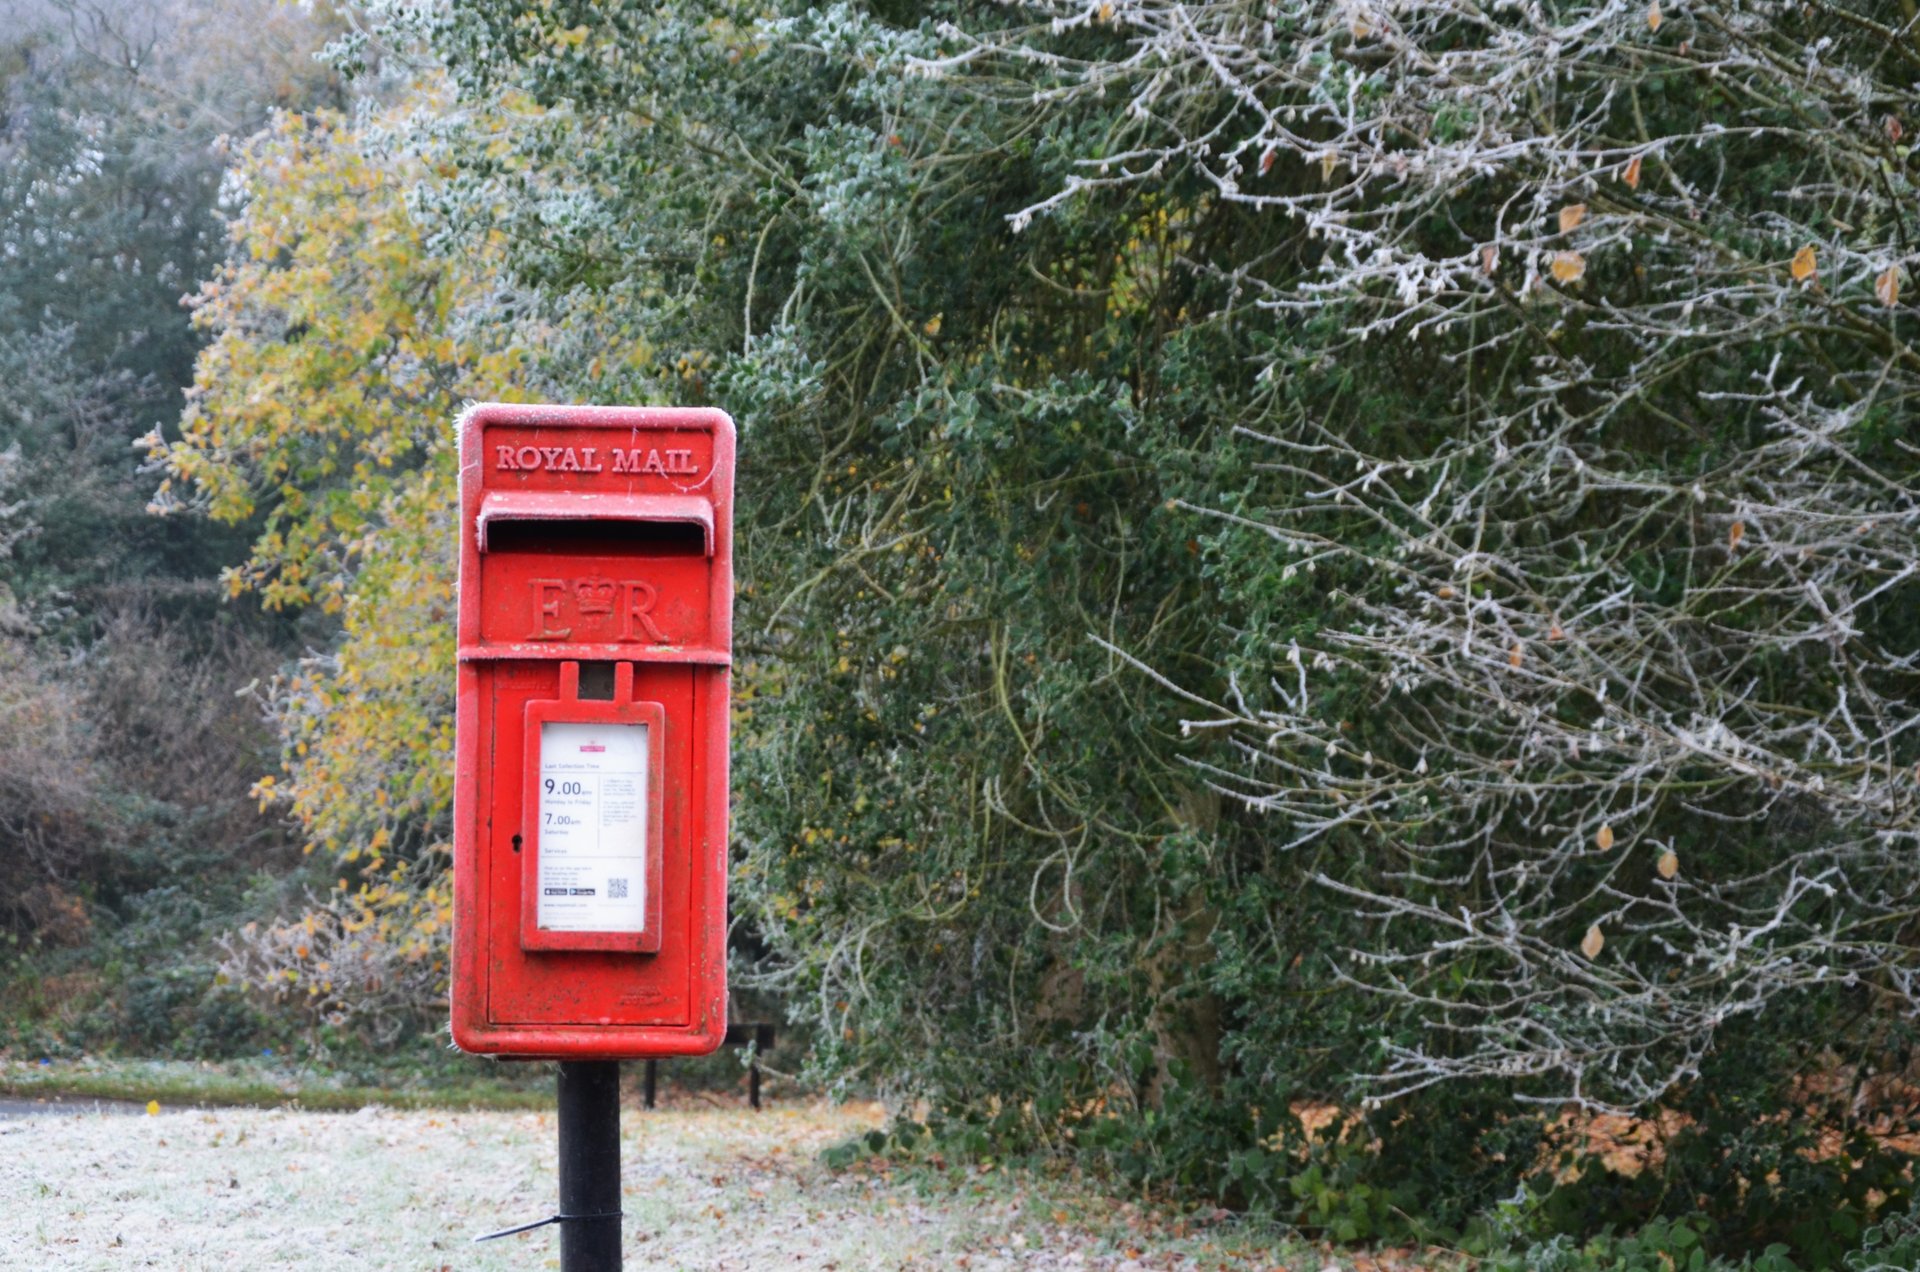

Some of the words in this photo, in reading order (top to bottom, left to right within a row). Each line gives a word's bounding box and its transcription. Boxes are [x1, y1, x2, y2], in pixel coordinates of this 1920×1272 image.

[496, 445, 602, 472] ROYAL
[612, 448, 699, 474] MAIL
[526, 578, 571, 640] E
[617, 579, 670, 642] R
